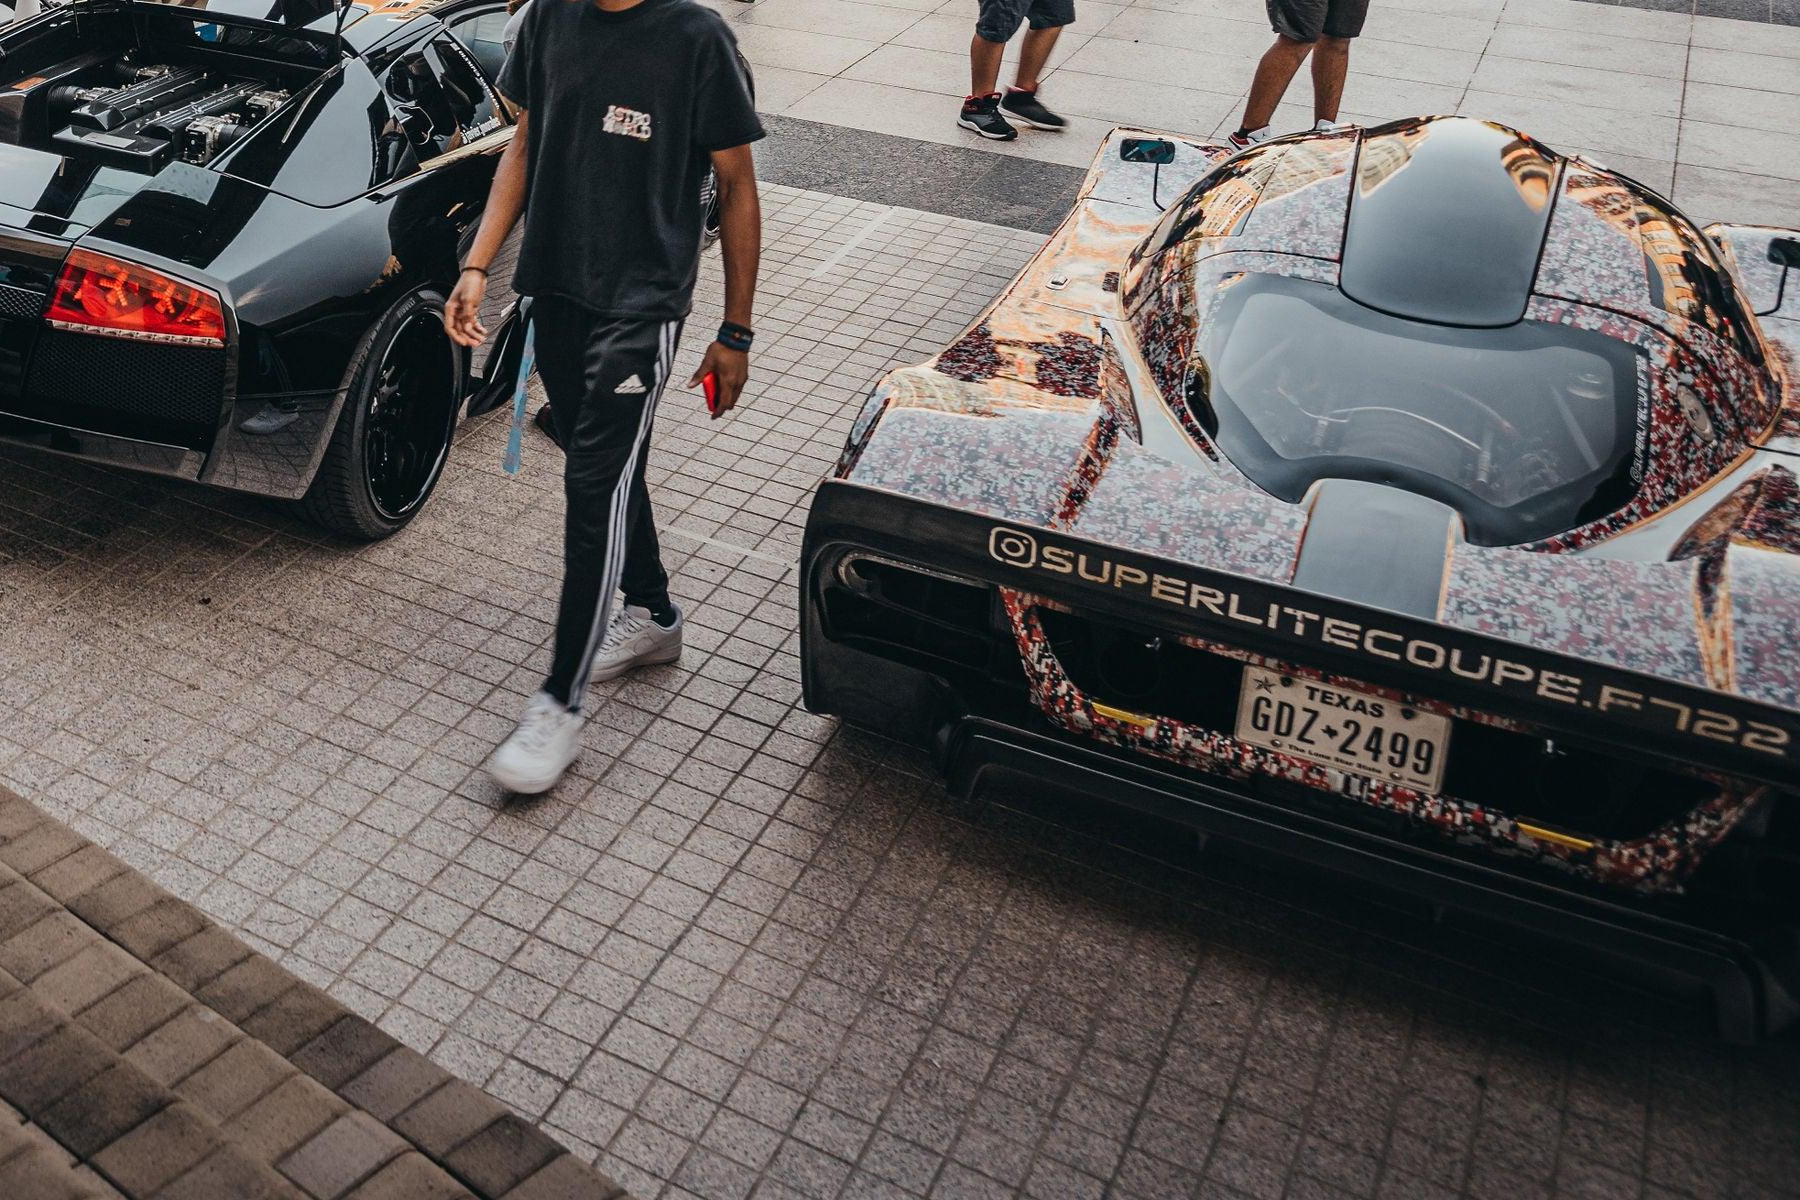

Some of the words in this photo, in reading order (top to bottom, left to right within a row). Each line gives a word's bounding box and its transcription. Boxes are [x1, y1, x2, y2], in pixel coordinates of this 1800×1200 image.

[1041, 545, 1792, 757] SUPERLITECOUPE.F722
[1305, 685, 1384, 718] TEXAS
[1251, 696, 1320, 746] GDZ
[1338, 718, 1435, 776] 2499
[1287, 743, 1307, 755] The
[1307, 749, 1332, 761] Lone
[1333, 756, 1355, 769] Star
[1356, 763, 1383, 775] State
